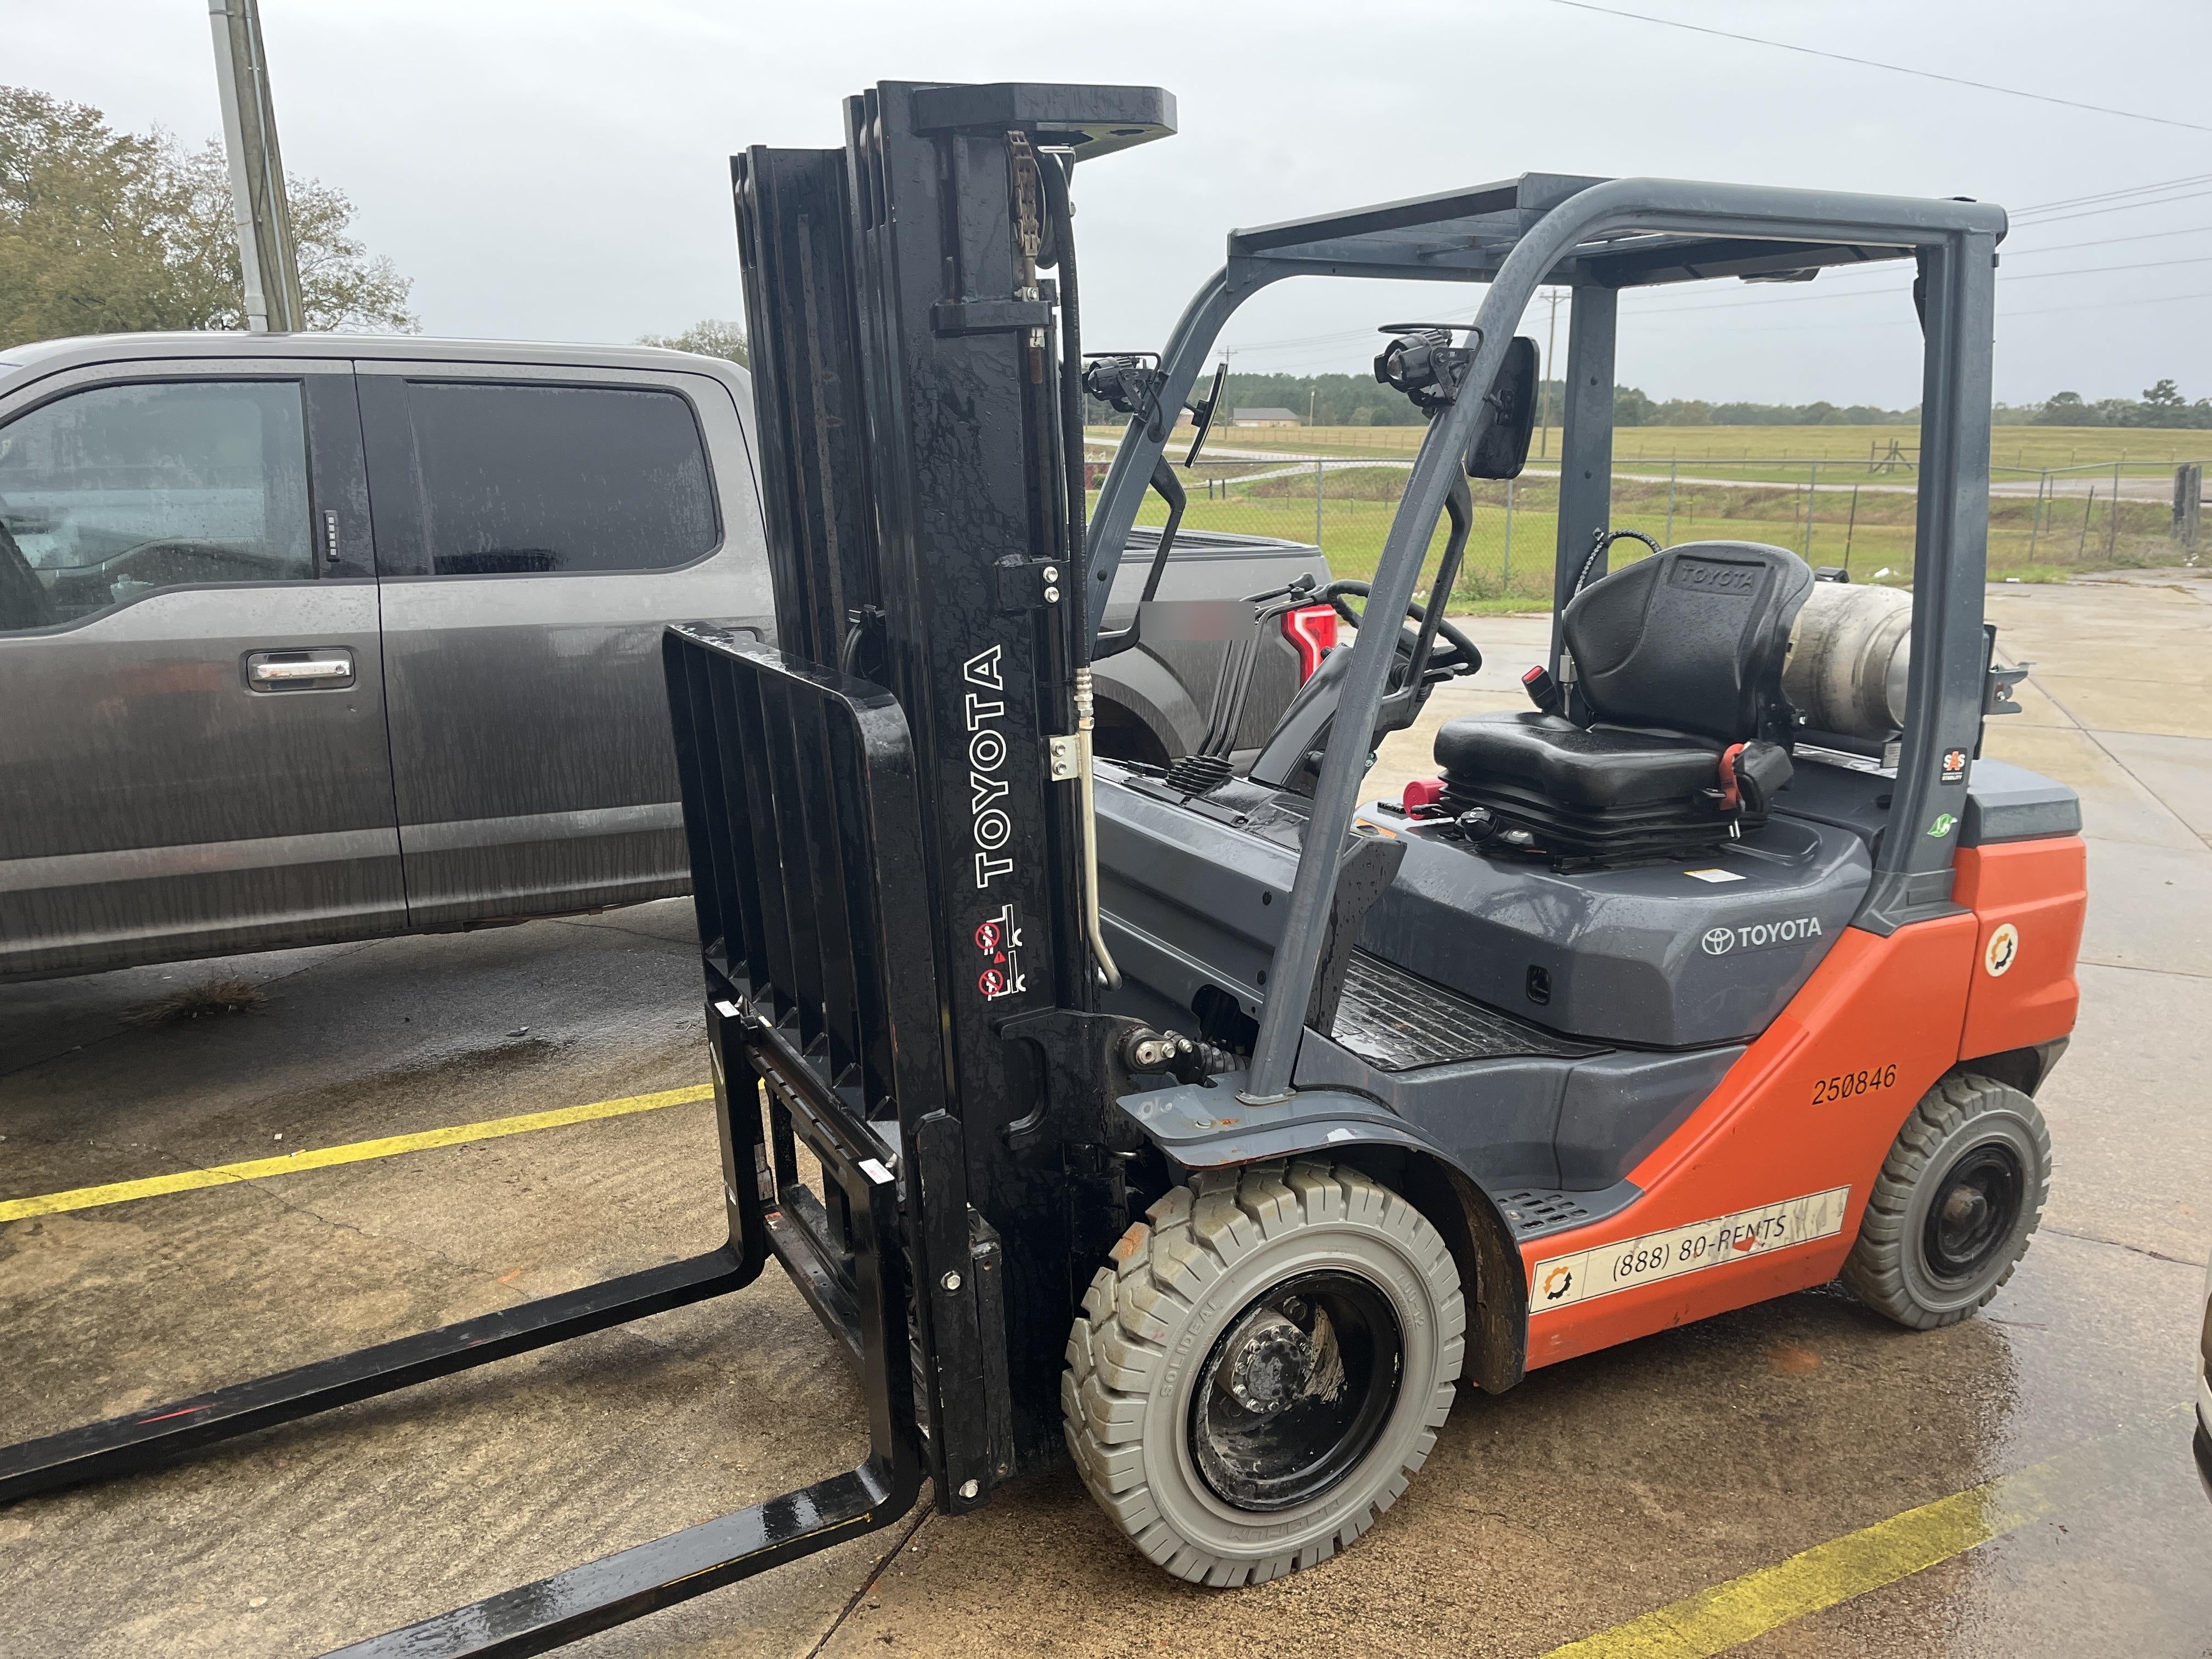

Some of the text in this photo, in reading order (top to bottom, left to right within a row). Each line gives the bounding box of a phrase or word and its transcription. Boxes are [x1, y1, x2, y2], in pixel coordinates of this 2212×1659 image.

[1681, 565, 1754, 590] TOYOTA
[963, 645, 1013, 888] TOYOTA
[1943, 751, 1965, 771] SAS
[1738, 917, 1822, 947] TOYOTA
[1812, 1064, 1897, 1105] 250846
[1613, 1215, 1786, 1282] (888) 80-RENTS
[1160, 1300, 1220, 1397] SOLIDEAL
